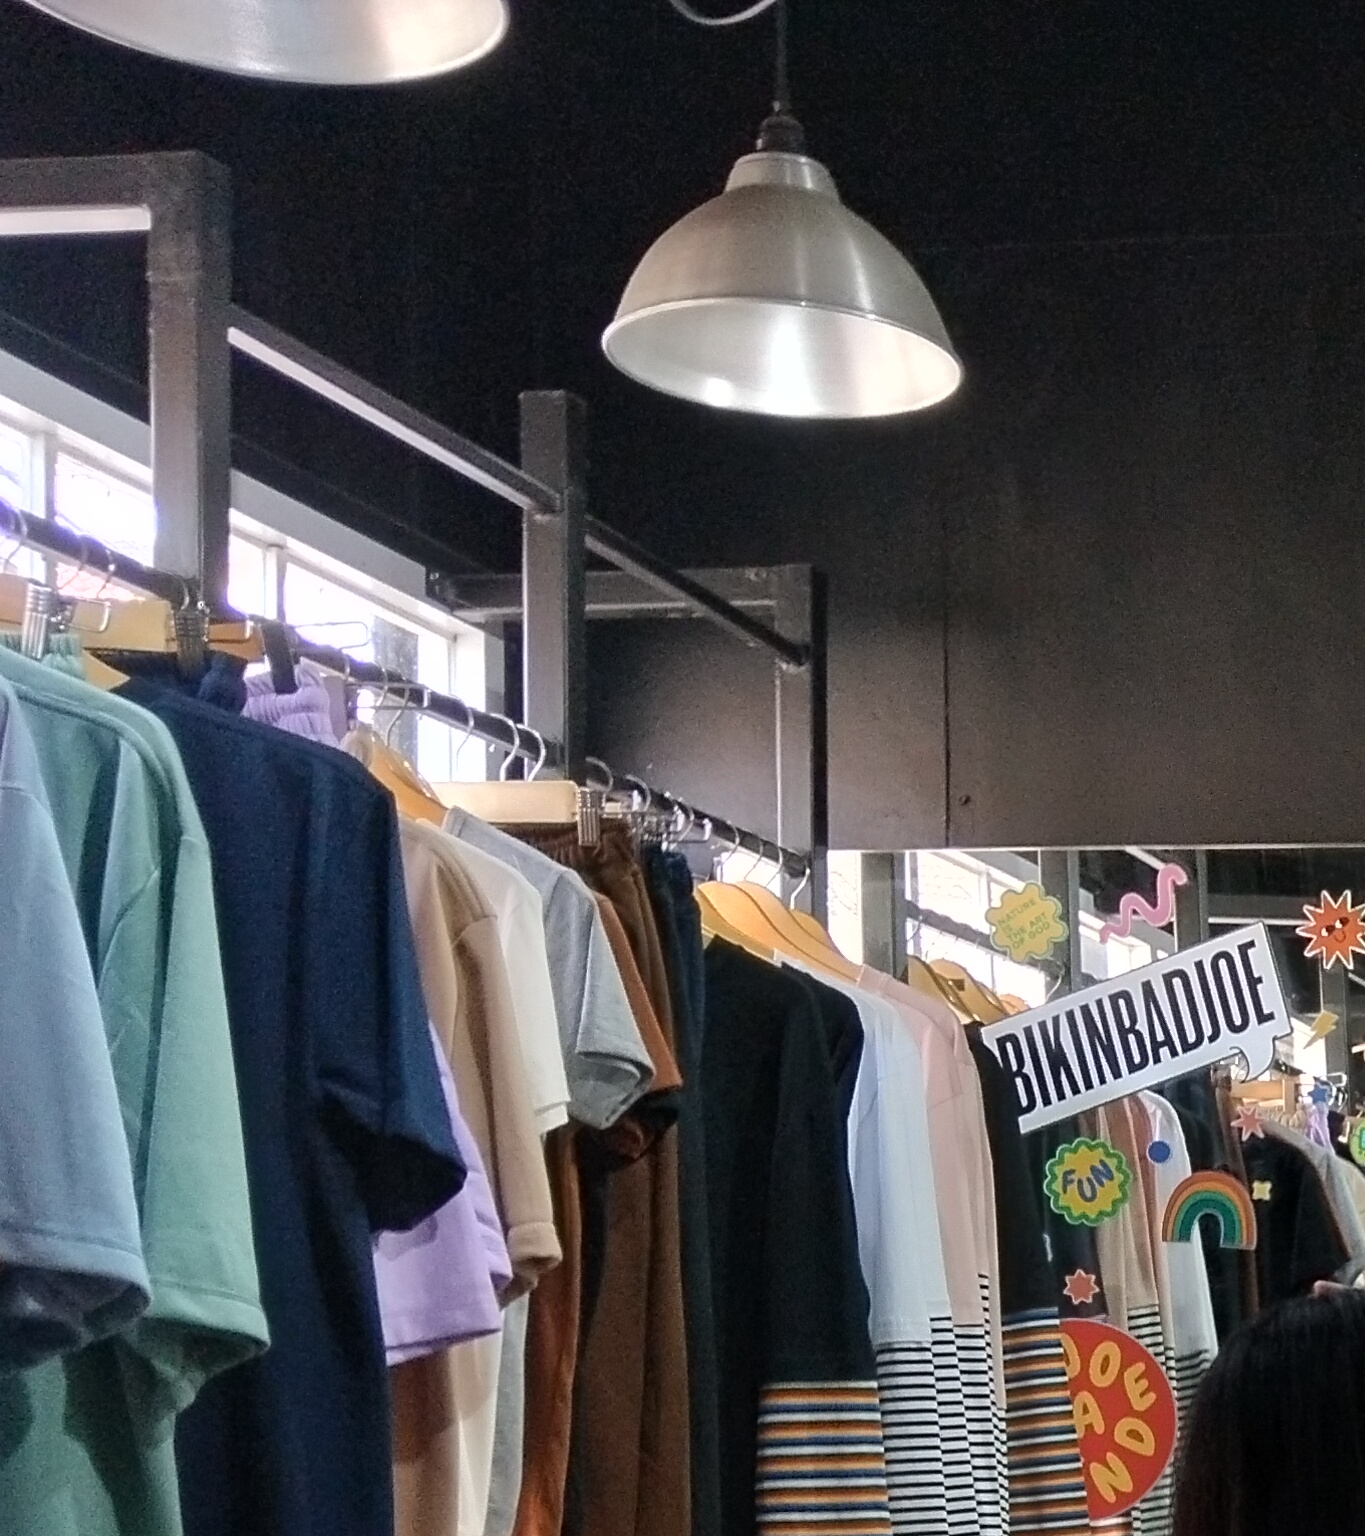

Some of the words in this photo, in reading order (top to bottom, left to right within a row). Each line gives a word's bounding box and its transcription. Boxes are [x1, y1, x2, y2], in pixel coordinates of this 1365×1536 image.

[997, 898, 1037, 926] NATURE
[1029, 912, 1047, 929] ART
[1012, 936, 1026, 949] OF
[1028, 922, 1051, 940] GOD
[995, 940, 1276, 1116] BIKINBADJOE
[1061, 1158, 1115, 1203] FUN
